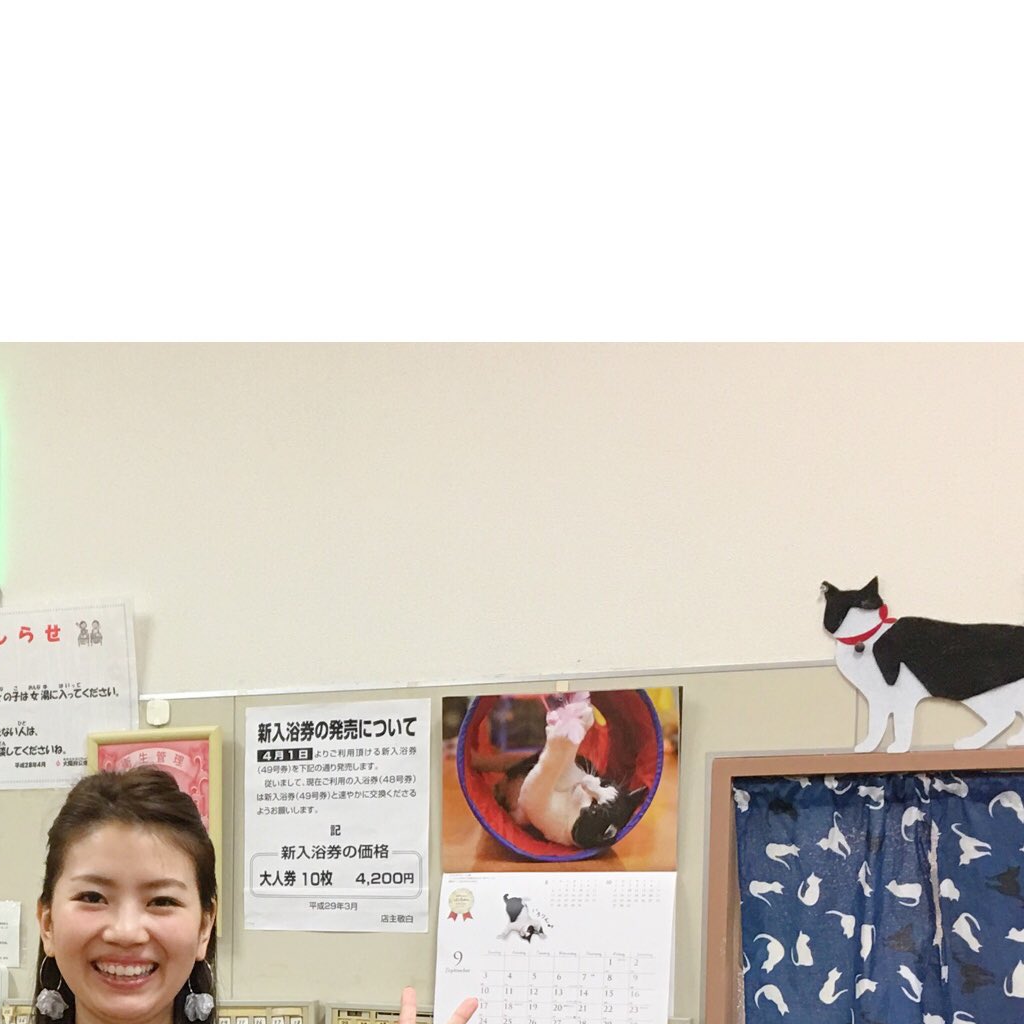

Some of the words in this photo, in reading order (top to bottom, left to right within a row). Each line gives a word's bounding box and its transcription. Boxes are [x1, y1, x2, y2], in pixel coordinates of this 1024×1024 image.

[257, 717, 417, 743] 新入浴券の発売について
[262, 750, 309, 761] 4月1日
[330, 824, 341, 837] 記
[281, 844, 389, 860] 新入浴券の価格
[259, 870, 296, 887] 大人券
[302, 870, 333, 887] 10枚
[355, 871, 414, 887] 4,200円
[309, 901, 358, 911] 平成29年3月
[453, 951, 463, 967] 9
[609, 958, 612, 966] 1
[634, 958, 639, 966] 2
[579, 989, 588, 997] 14
[603, 1005, 613, 1013] 22
